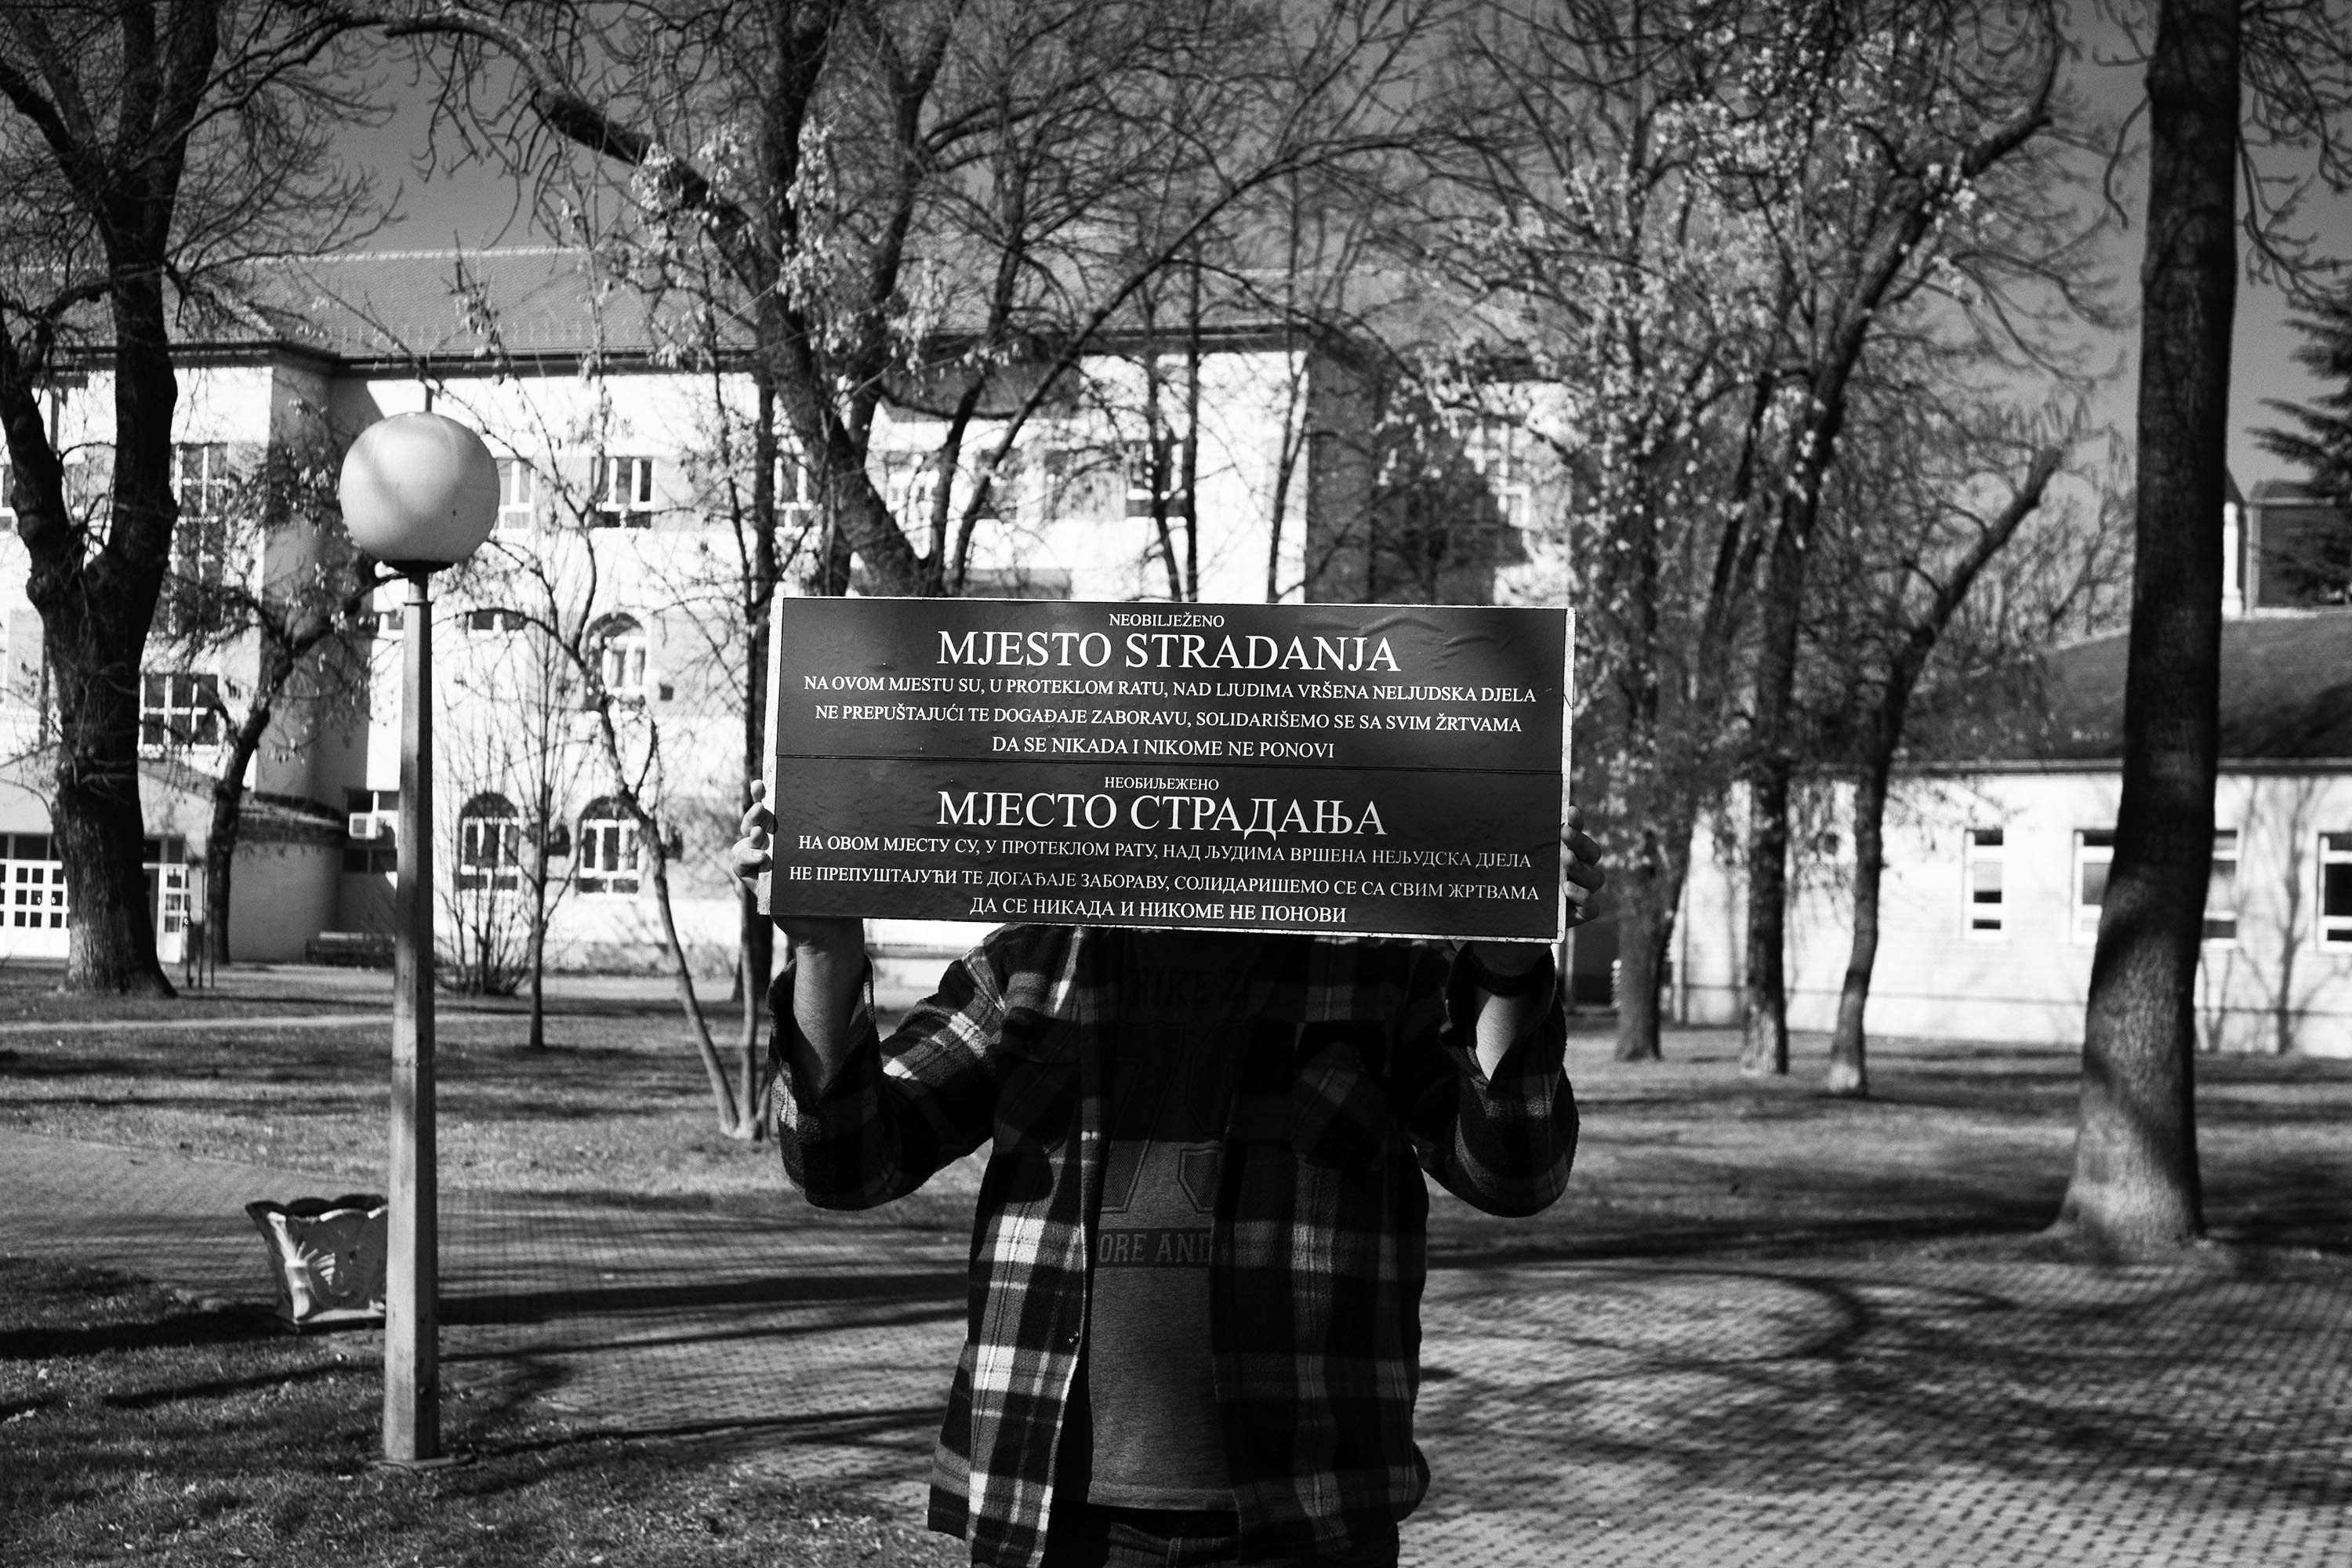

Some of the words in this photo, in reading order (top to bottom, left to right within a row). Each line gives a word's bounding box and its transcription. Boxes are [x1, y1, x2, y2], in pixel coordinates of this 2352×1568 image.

[1109, 611, 1225, 628] NEOBILJEŽENO
[935, 630, 1112, 667] MJESTO
[1125, 632, 1403, 672] STRADANJA
[804, 675, 829, 690] NA
[831, 676, 886, 691] OVOM
[887, 677, 955, 692] MJESTU
[958, 677, 985, 695] SU,
[989, 678, 1004, 693] U
[1005, 678, 1115, 695] PROTEKLOM
[1117, 681, 1169, 699] RATU,
[1172, 681, 1212, 697] NAD
[1215, 682, 1294, 699] LJUDIMA
[1297, 681, 1370, 699] VRŠENA
[1371, 684, 1478, 702] NELJUDSKA
[1480, 687, 1537, 702] DJELA
[815, 705, 839, 720] NE
[841, 702, 965, 722] PREPUŠTAJUĆI
[967, 707, 990, 722] TE
[993, 708, 1087, 725] DOGAĐAJE
[1091, 710, 1192, 728] ZABORAVU,
[1196, 710, 1330, 728] SOLIDARIŠEMO
[1334, 714, 1356, 729] SE
[1359, 714, 1383, 730] SA
[1385, 714, 1432, 731] SVIM
[1435, 712, 1523, 732] ŽRTVAMA
[991, 736, 1021, 753] DA
[1024, 736, 1047, 753] SE
[1051, 737, 1130, 754] NIKADA
[1131, 739, 1140, 755] I
[1143, 739, 1223, 757] NIKOME
[1227, 740, 1254, 757] NE
[1258, 741, 1335, 759] PONOVI
[1104, 776, 1220, 791] НЕОБИЉЕЖЕНО
[935, 790, 1117, 829] МЈЕСТО
[1130, 794, 1388, 841] СТРАДАЊА
[797, 835, 824, 850] НА
[826, 835, 880, 851] ОВОМ
[883, 837, 952, 853] МЈЕСТУ
[954, 838, 980, 856] СУ,
[984, 839, 998, 854] У
[1001, 840, 1110, 856] ПРОТЕКЛОМ
[1114, 842, 1159, 860] РАТУ,
[1162, 844, 1201, 862] НАД
[1204, 844, 1286, 863] ЉУДИМА
[1289, 847, 1367, 863] ВРШЕНА
[1371, 849, 1472, 869] НЕЉУДСКА
[1475, 852, 1532, 869] ДЈЕЛА
[789, 866, 813, 880] НЕ
[815, 866, 958, 884] ПРЕПУШТАЈУЋИ
[961, 869, 983, 885] ТЕ
[985, 871, 1077, 888] ДОГАЂАЈЕ
[1080, 873, 1170, 892] ЗАБОРАВУ,
[1174, 875, 1330, 895] СОЛИДАРИШЕМО
[1334, 880, 1358, 895] СЕ
[1361, 880, 1386, 896] СА
[1389, 881, 1443, 898] СВИМ
[1448, 884, 1540, 901] ЖРТВАМА
[969, 897, 998, 916] ДА
[1002, 898, 1028, 914] СЕ
[1032, 898, 1116, 920] НИКАДА
[1120, 901, 1135, 917] И
[1138, 901, 1225, 920] НИКОМЕ
[1229, 904, 1257, 920] НЕ
[1260, 905, 1348, 924] ПОНОВИ
